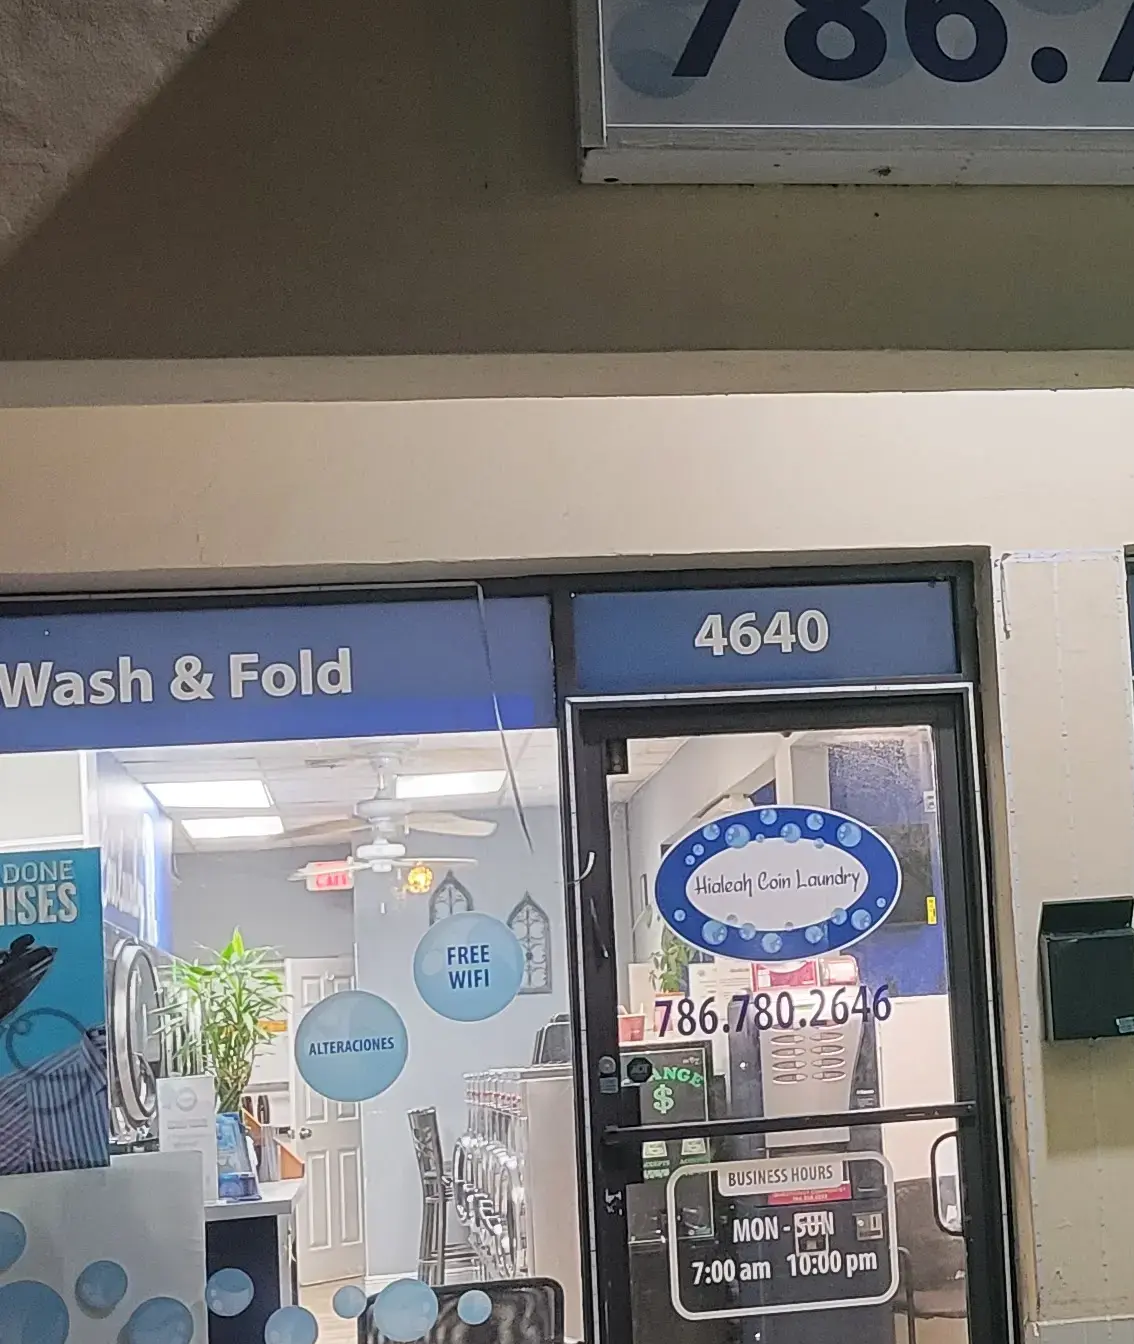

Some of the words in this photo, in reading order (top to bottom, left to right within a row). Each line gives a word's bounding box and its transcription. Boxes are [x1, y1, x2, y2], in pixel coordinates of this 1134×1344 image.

[694, 608, 830, 657] 4640
[0, 655, 154, 708] Wash
[169, 654, 215, 701] &
[229, 647, 352, 699] Fold
[3, 859, 75, 885] DONE
[694, 872, 753, 898] Hialeah
[757, 871, 791, 891] Coin
[796, 866, 861, 893] Laundry
[0, 882, 78, 926] ISES
[447, 944, 490, 966] FREE
[448, 968, 490, 989] WIFI
[654, 984, 893, 1038] 786.780.2646
[308, 1036, 395, 1056] ALTERACIONES
[647, 1066, 704, 1089] ANGE
[728, 1169, 788, 1187] BUSINESS
[791, 1165, 834, 1183] HOURS
[733, 1216, 779, 1244] MON
[796, 1211, 835, 1237] SUN
[691, 1259, 737, 1285] 7:00
[740, 1260, 772, 1280] am
[786, 1250, 842, 1278] 10:00
[846, 1252, 878, 1278] pm
